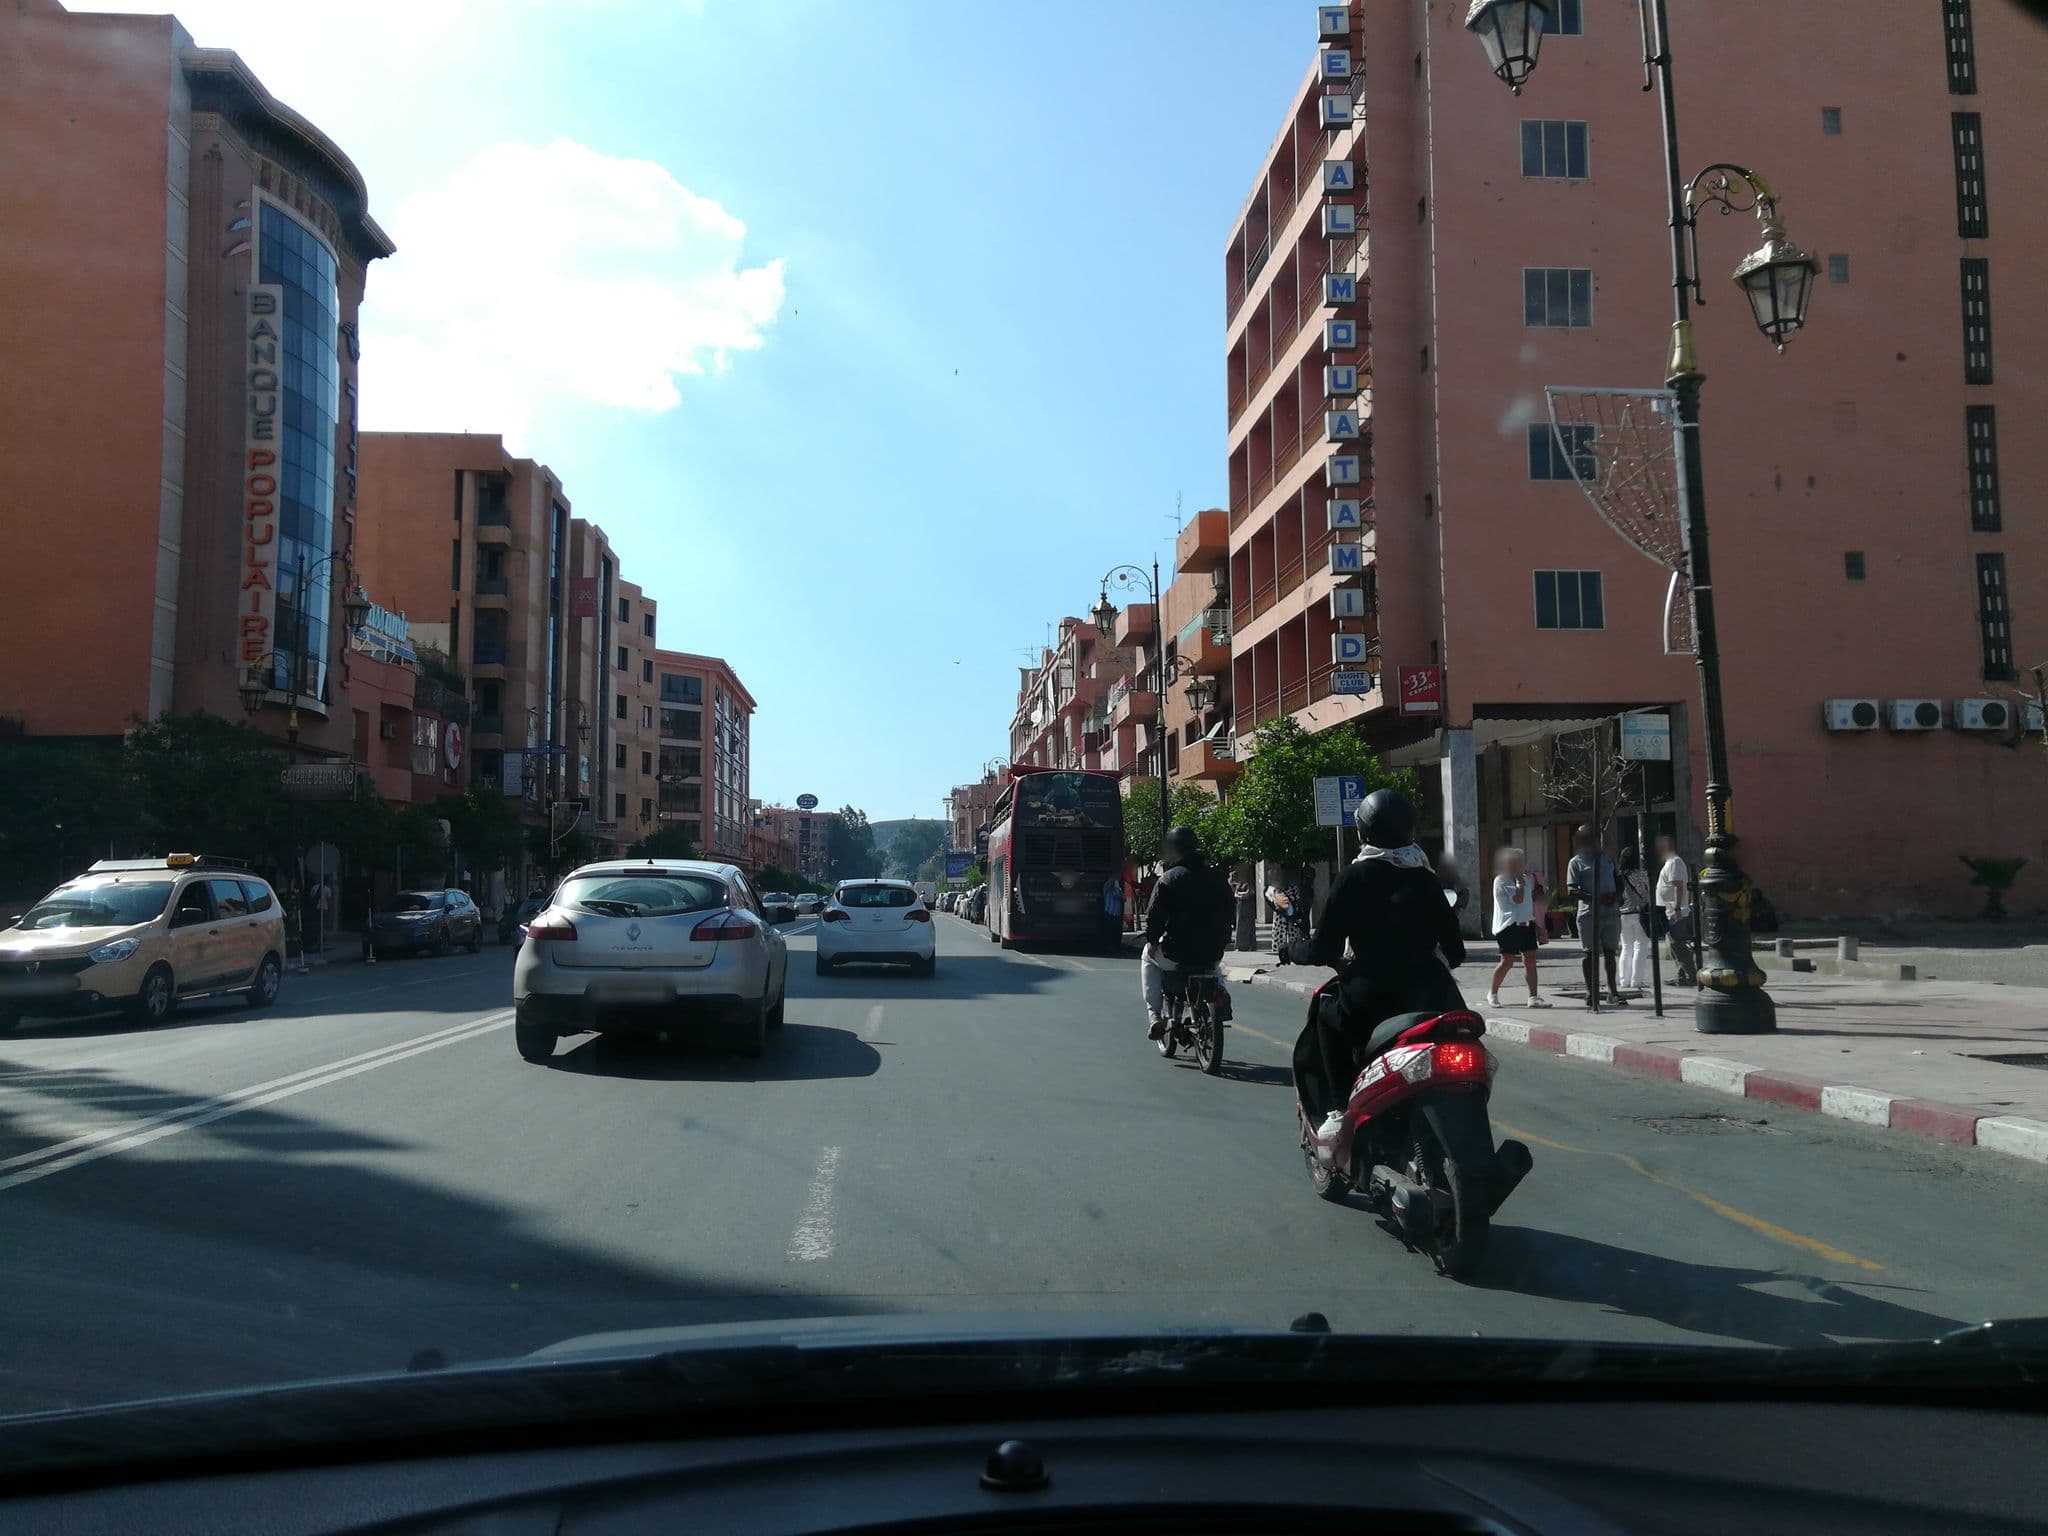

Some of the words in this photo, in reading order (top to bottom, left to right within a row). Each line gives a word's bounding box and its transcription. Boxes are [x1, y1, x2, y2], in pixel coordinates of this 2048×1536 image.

[249, 293, 278, 441] BANQUE
[240, 449, 276, 662] POPULAIRE
[1338, 672, 1365, 680] NIGHT
[280, 768, 312, 785] GALERIE
[313, 768, 354, 785] BERTRAND
[1344, 781, 1358, 799] P
